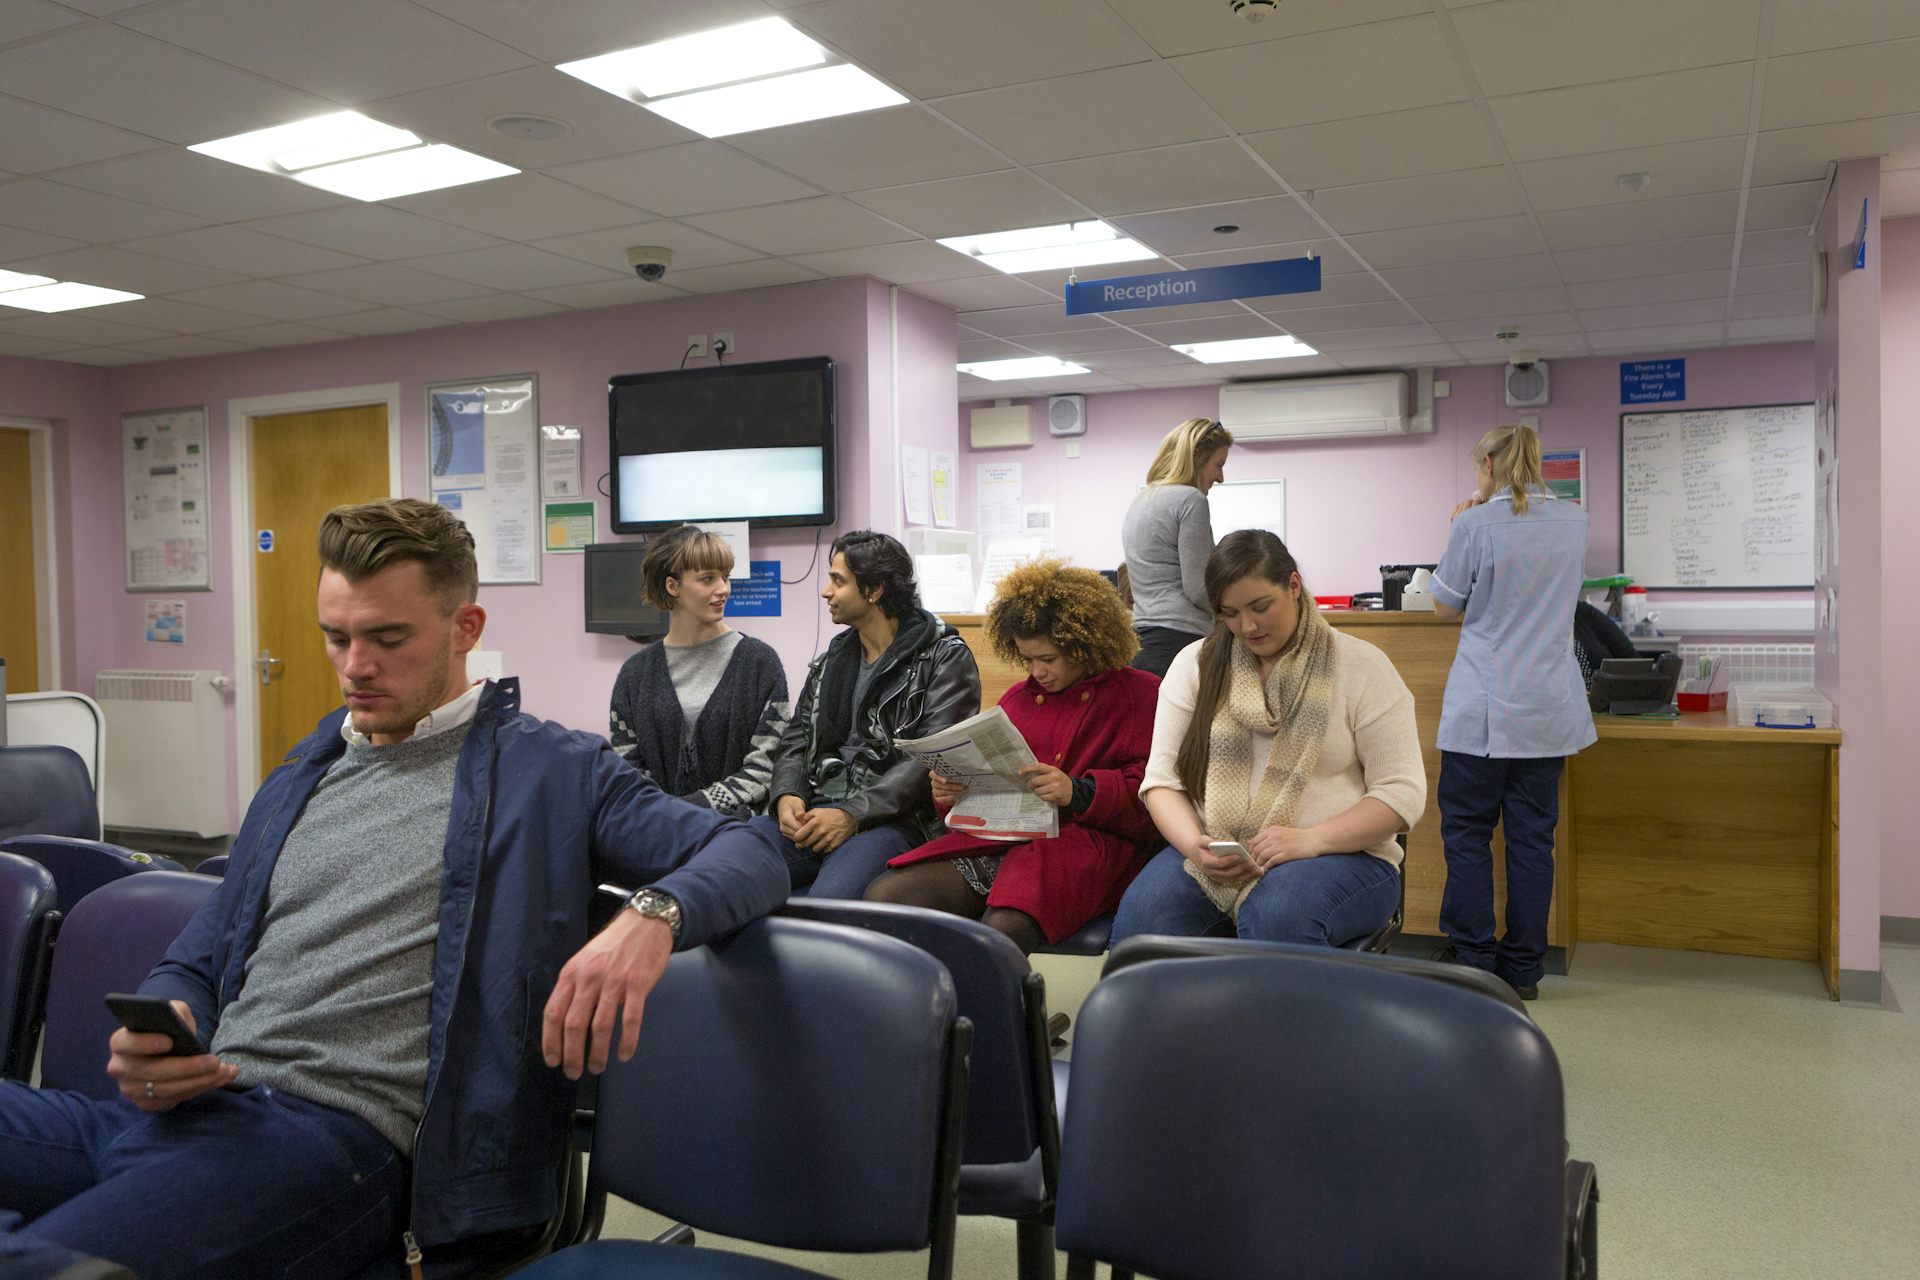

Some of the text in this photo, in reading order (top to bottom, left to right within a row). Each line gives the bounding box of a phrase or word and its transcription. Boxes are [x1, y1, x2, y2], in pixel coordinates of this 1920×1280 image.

[1104, 279, 1196, 301] Reception
[1634, 363, 1656, 372] There
[1624, 371, 1681, 382] Fire Alarm Test
[1641, 382, 1664, 391] Every
[1629, 390, 1677, 401] Tuesday AM
